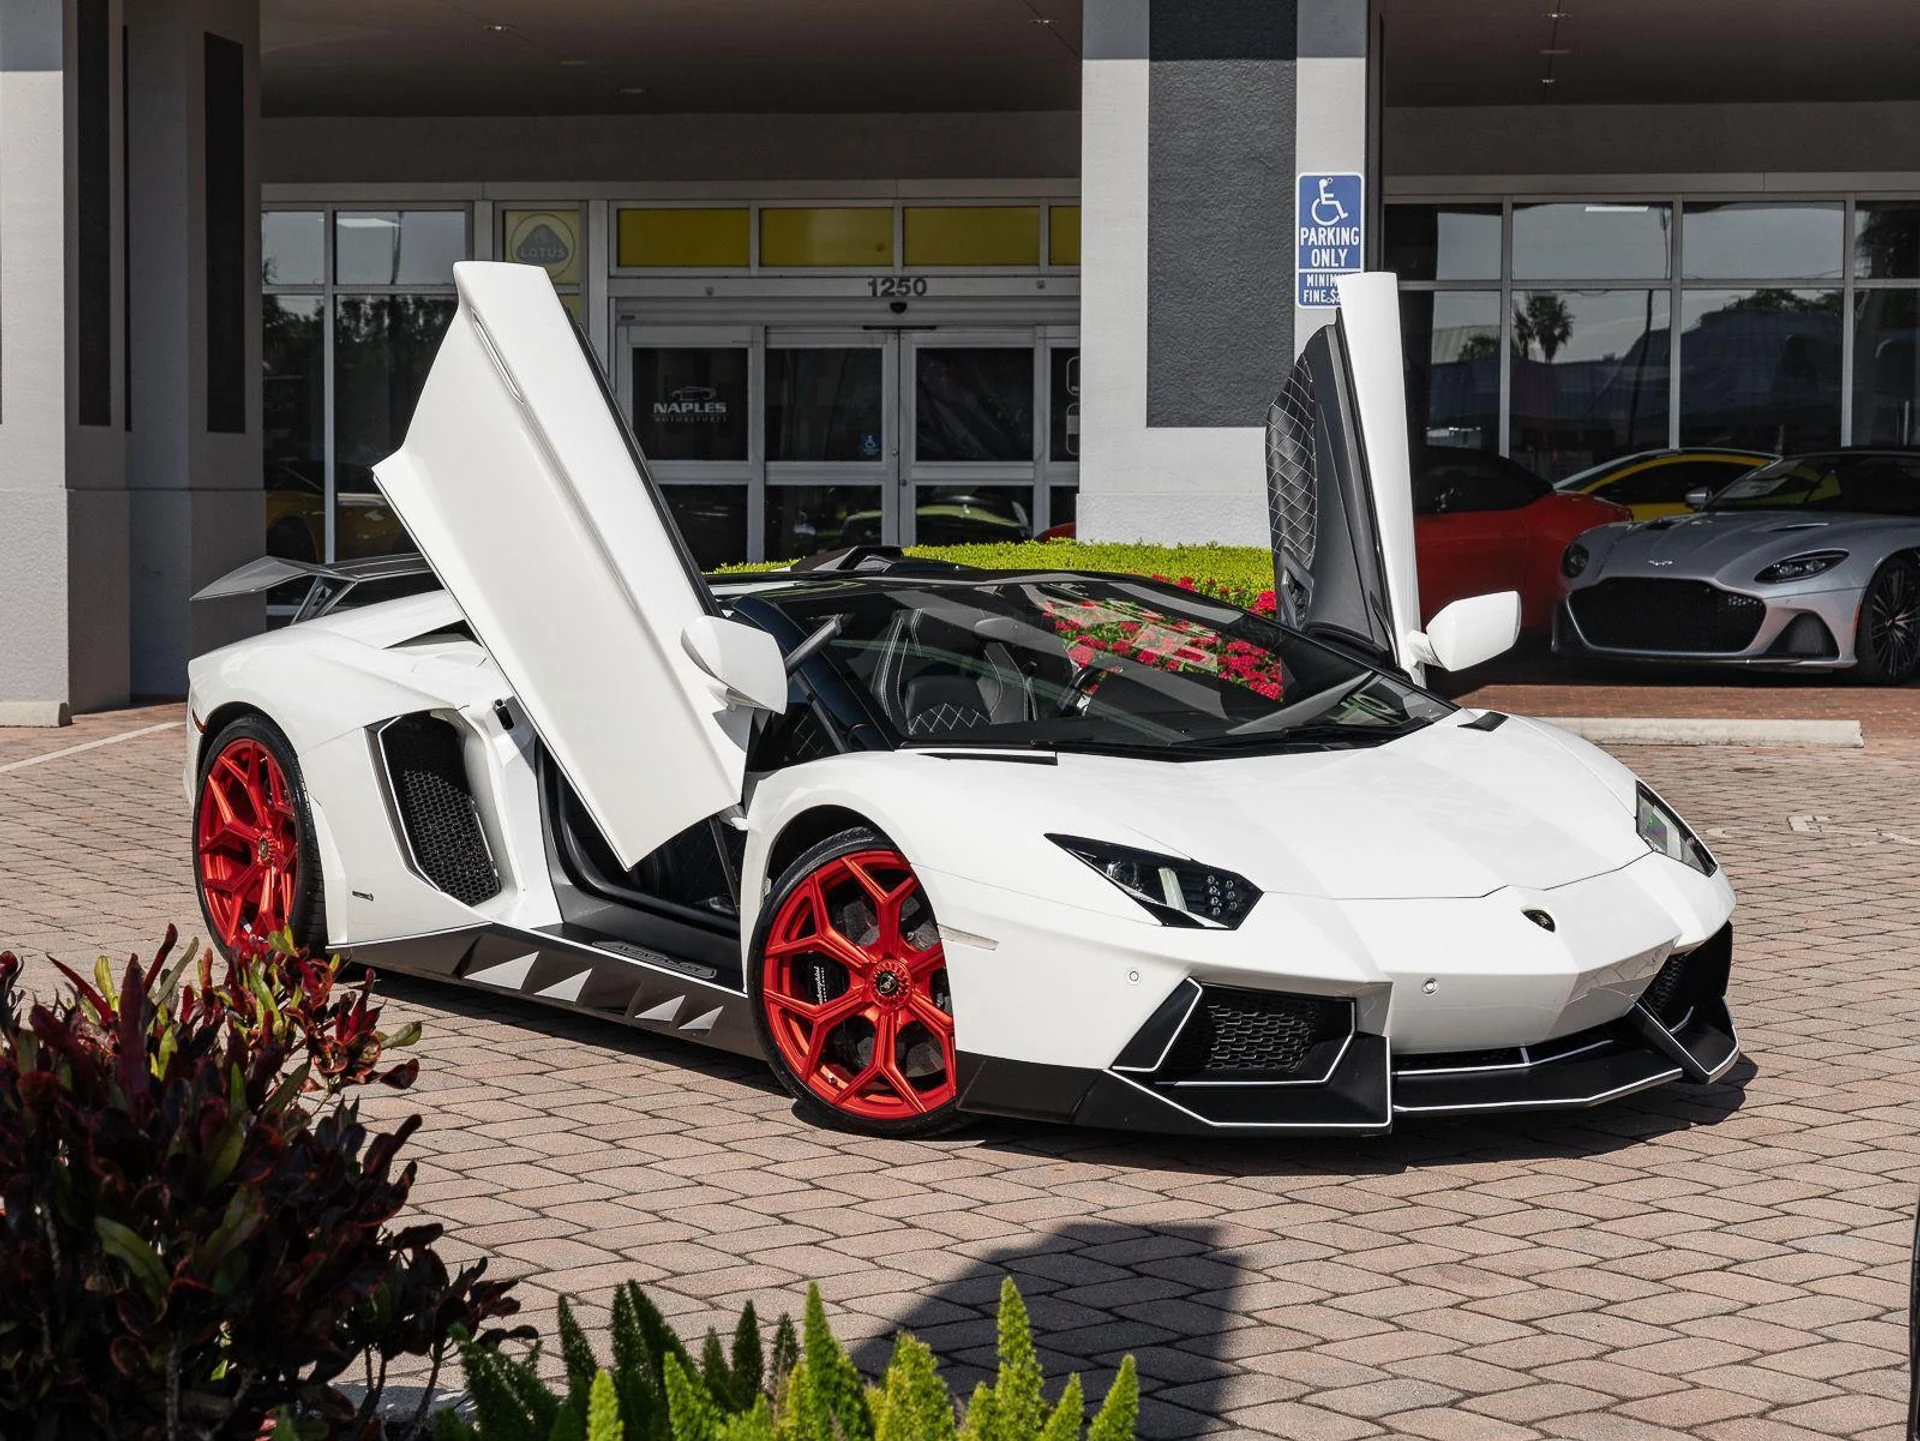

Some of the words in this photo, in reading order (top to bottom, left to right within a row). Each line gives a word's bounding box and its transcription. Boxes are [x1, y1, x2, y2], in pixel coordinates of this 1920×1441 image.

[1300, 227, 1360, 246] PARKING
[520, 247, 566, 258] LOTUS
[1311, 249, 1348, 267] ONLY
[868, 276, 928, 298] 1250
[1306, 273, 1337, 287] MINIM
[1303, 289, 1327, 303] FINE
[653, 402, 727, 414] NAPLES
